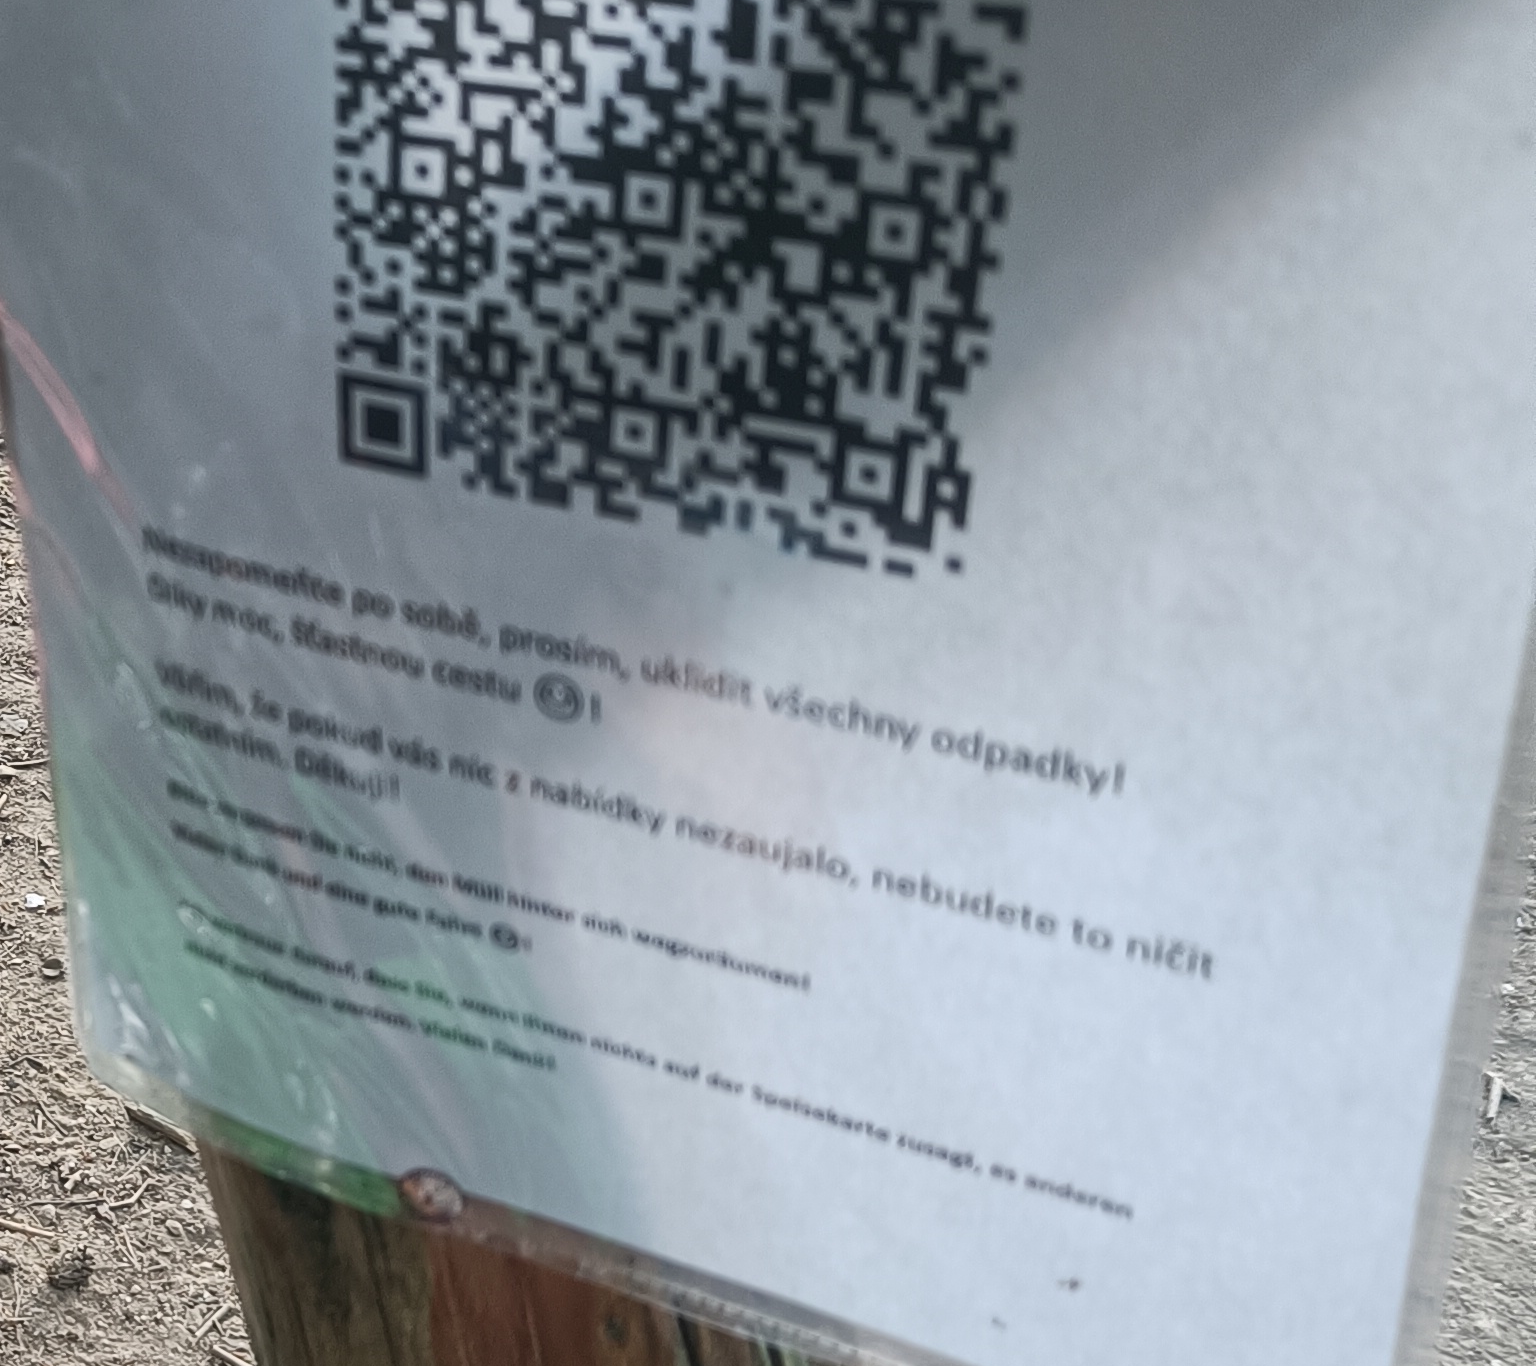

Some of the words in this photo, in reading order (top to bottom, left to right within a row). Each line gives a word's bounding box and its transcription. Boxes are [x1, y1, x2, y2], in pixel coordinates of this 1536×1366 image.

[351, 586, 395, 623] po
[763, 683, 921, 750] všechny
[931, 727, 1127, 797] odpadky!
[529, 773, 663, 835] nabídky
[674, 810, 860, 888] nezaujalo,
[872, 863, 1059, 939] nebudete
[1070, 915, 1113, 953] to
